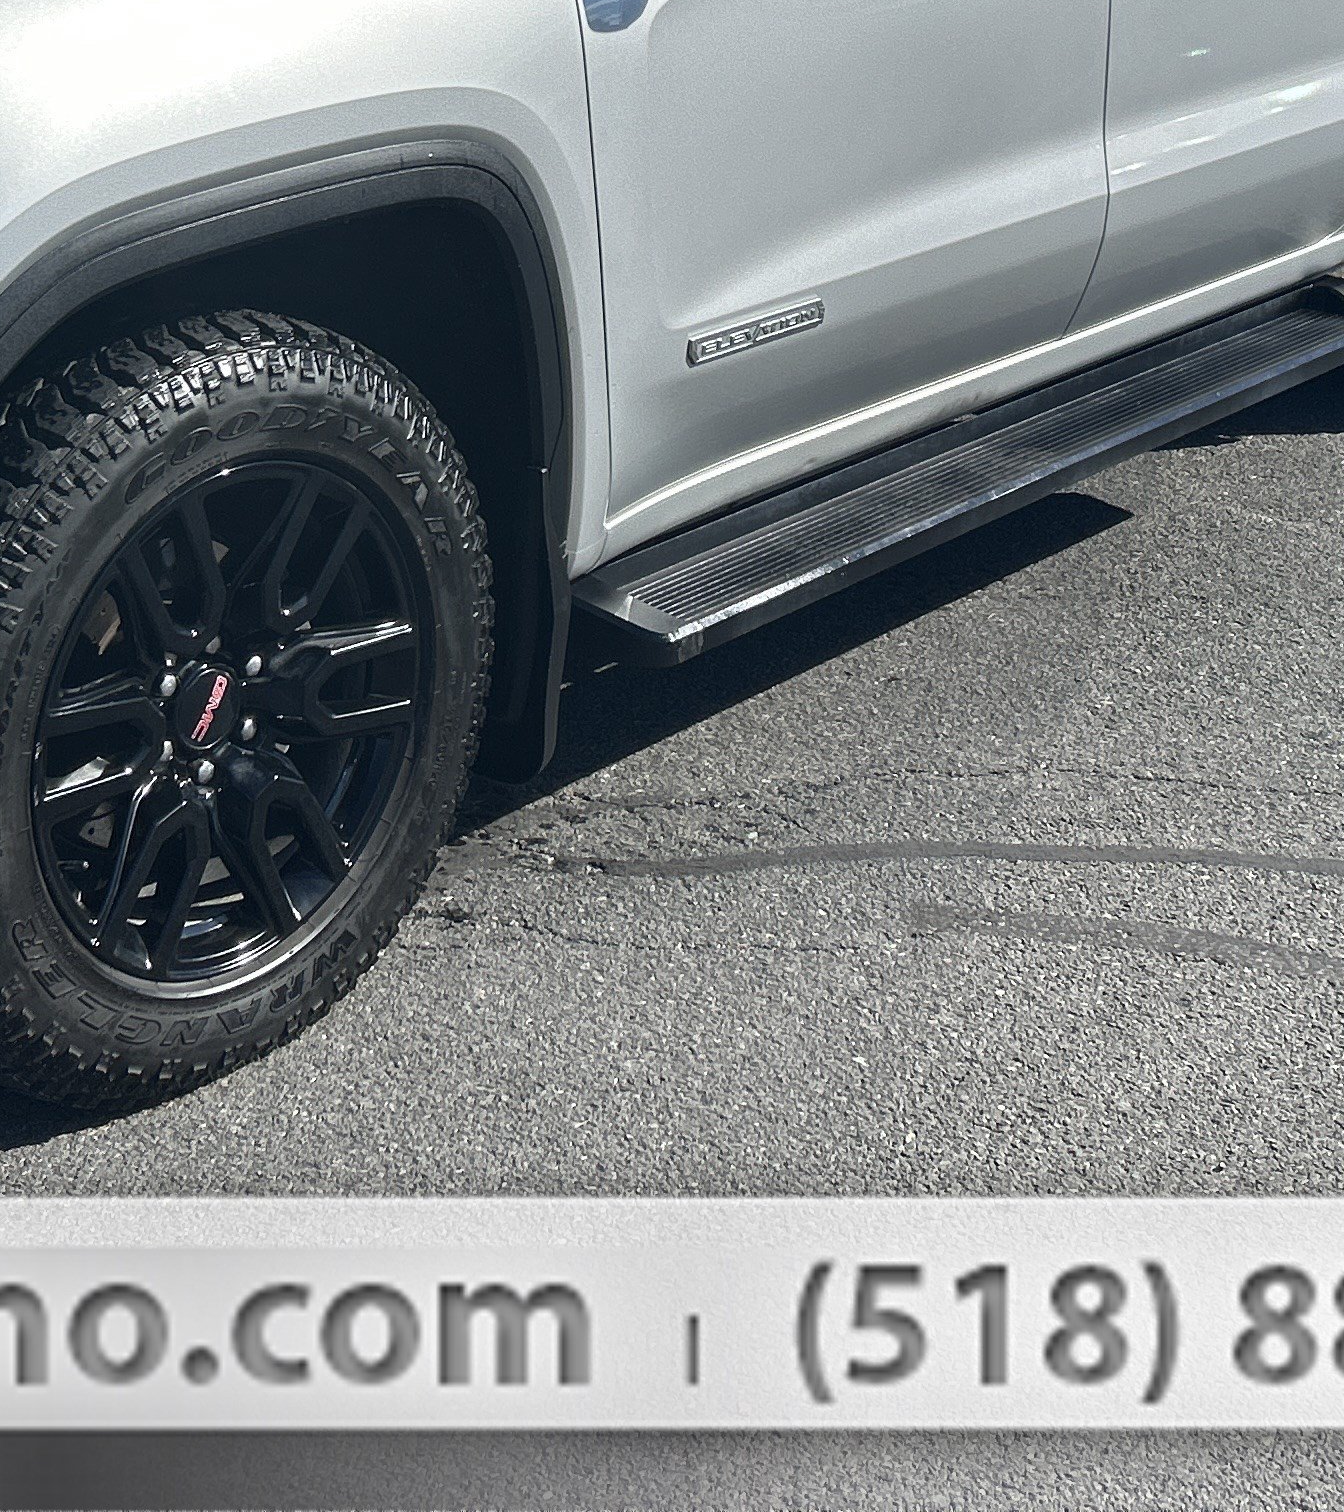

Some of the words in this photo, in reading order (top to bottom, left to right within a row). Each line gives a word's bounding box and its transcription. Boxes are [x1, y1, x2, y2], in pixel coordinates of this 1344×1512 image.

[700, 307, 818, 356] ELEVATION
[124, 404, 454, 556] GOODYEAR
[190, 674, 228, 742] GMC
[10, 919, 358, 1047] WRANGLER
